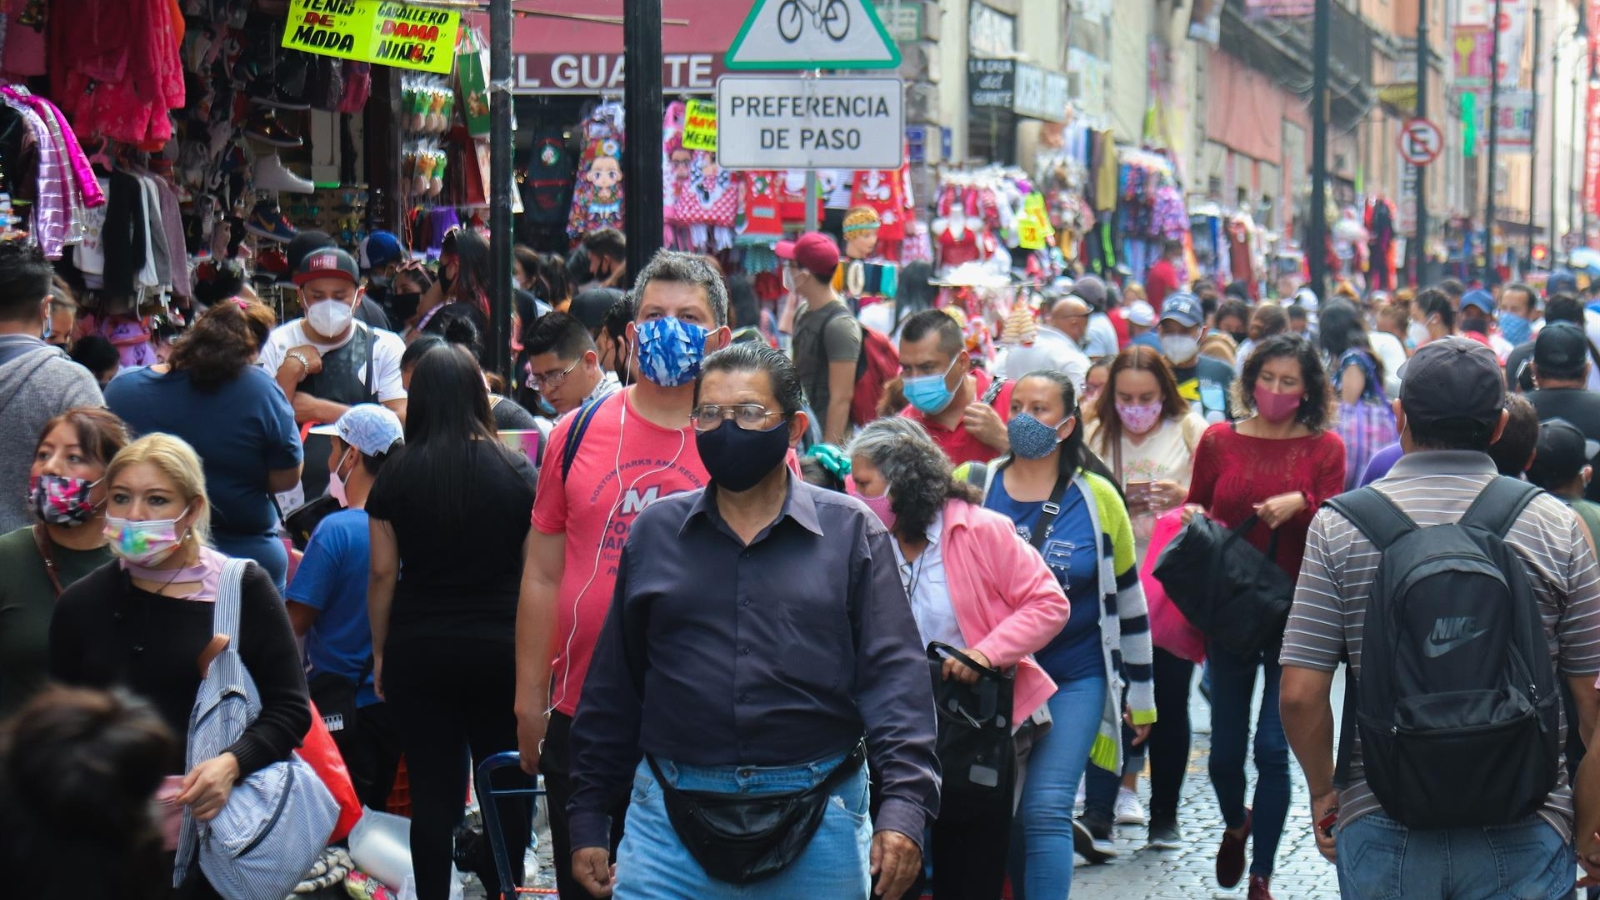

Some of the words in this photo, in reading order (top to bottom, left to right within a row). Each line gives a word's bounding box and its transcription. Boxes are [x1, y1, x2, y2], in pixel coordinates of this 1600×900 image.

[290, 26, 355, 53] MODA
[551, 55, 713, 88] GUATE
[731, 96, 890, 118] PREFERENCIA
[760, 128, 790, 150] DE
[800, 128, 861, 150] PASO
[620, 459, 652, 472] PARKS
[654, 459, 677, 470] AND
[1431, 616, 1477, 640] NIKE
